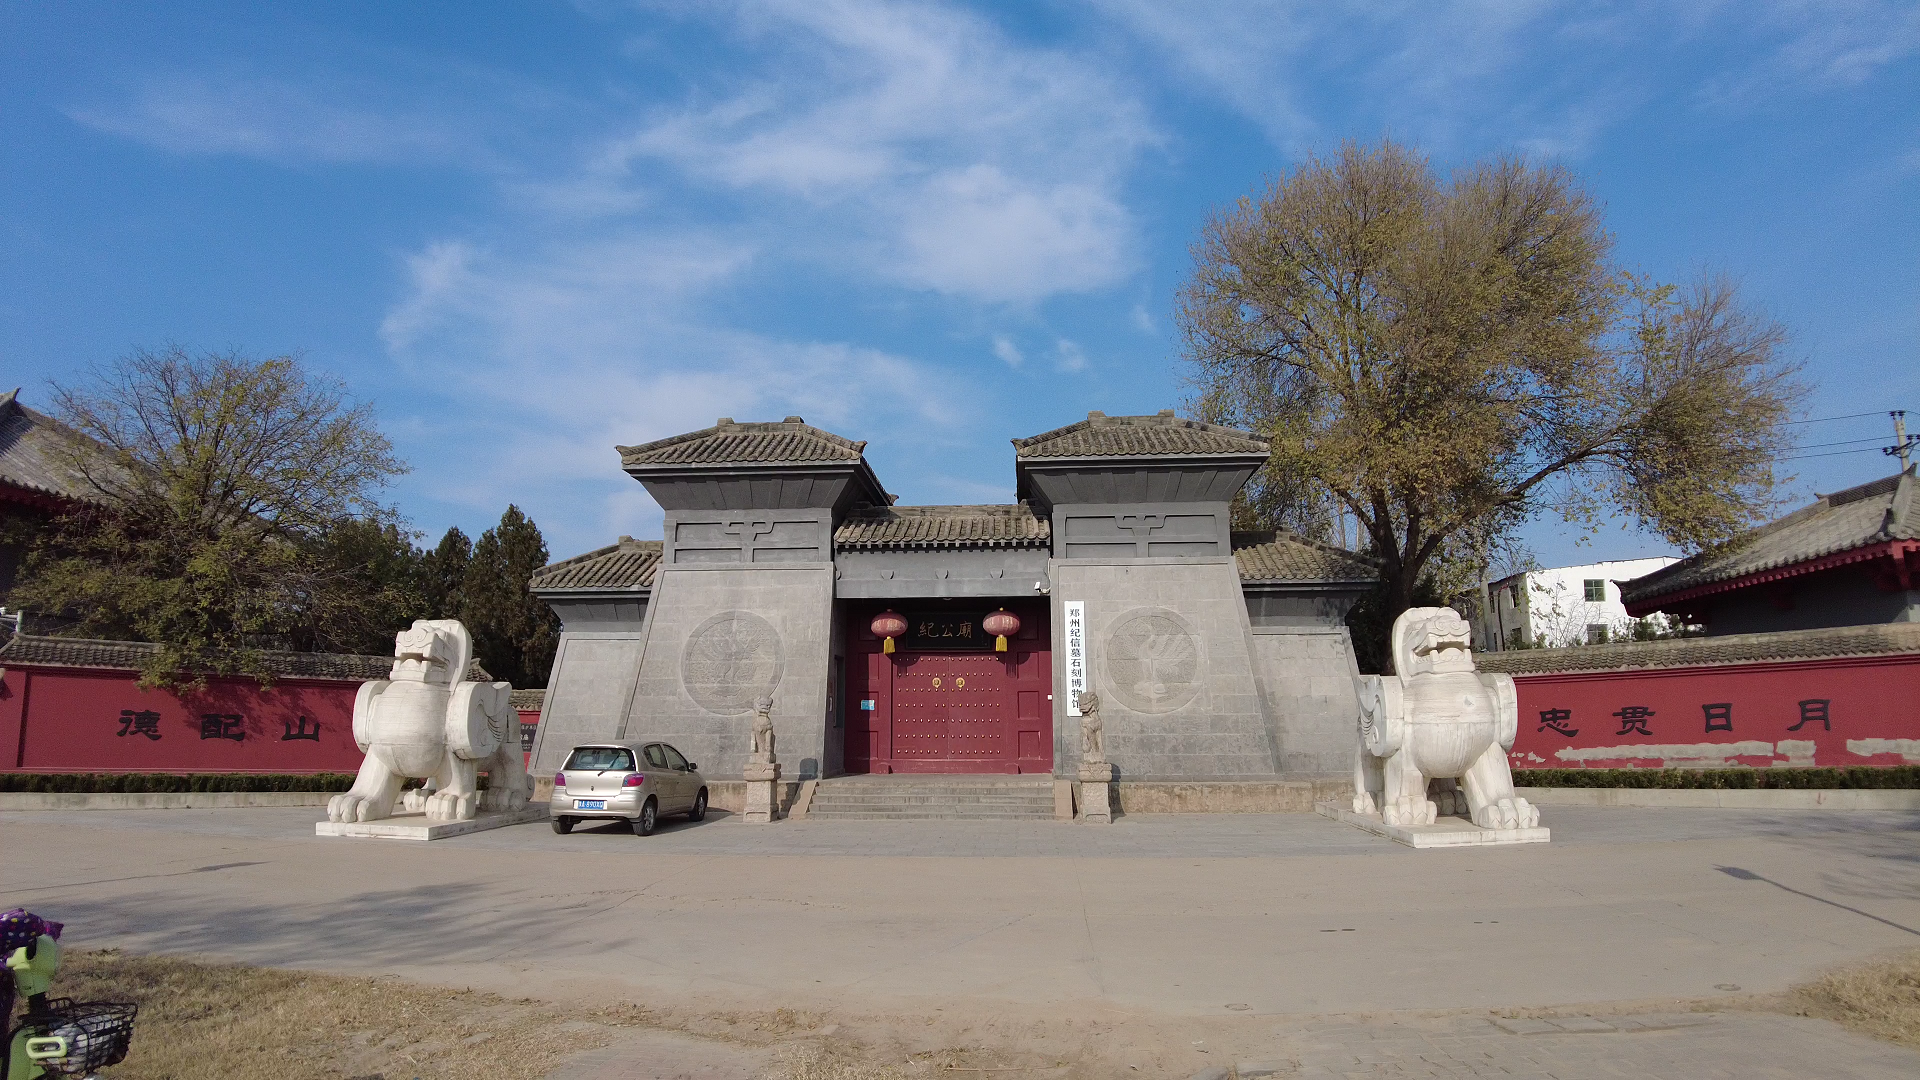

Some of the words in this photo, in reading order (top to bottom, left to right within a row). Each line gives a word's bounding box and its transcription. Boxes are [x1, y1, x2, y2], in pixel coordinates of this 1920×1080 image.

[917, 621, 972, 639] 紀公廟
[1537, 699, 1831, 738] 忠贯日月
